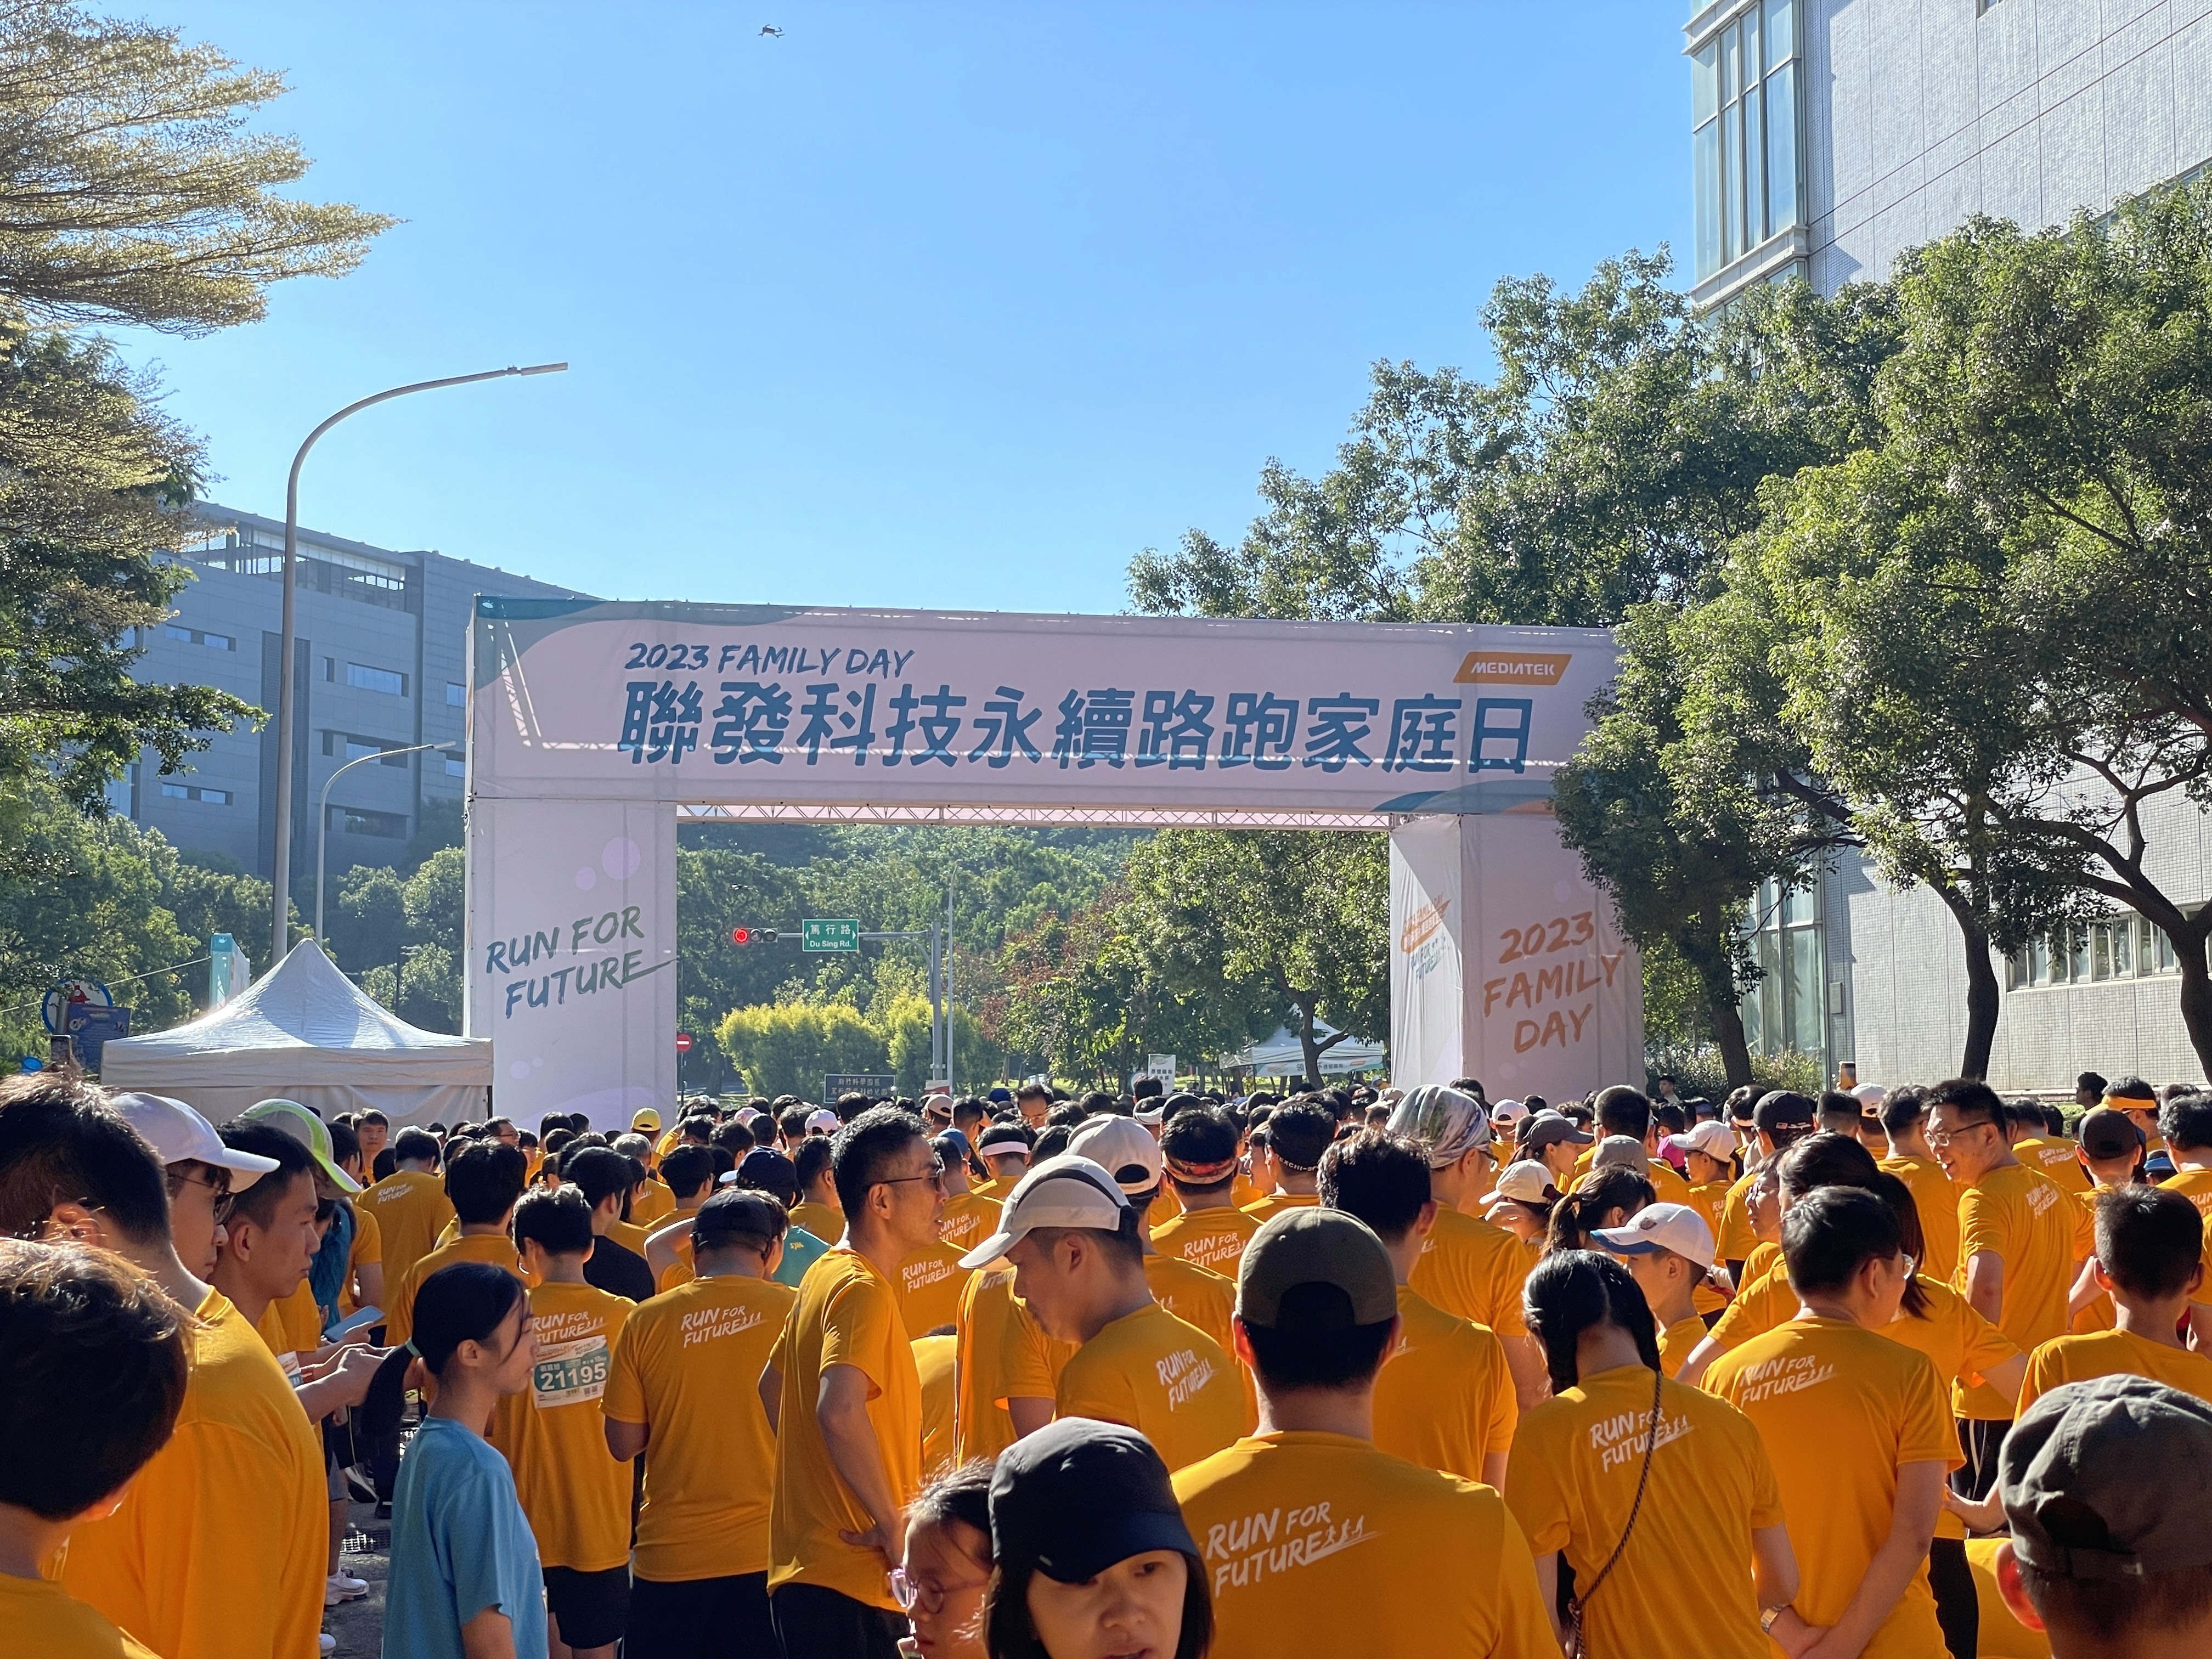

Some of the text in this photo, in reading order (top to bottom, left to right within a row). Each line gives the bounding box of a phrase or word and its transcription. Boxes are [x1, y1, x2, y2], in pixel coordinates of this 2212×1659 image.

[625, 642, 915, 679] 2023 FAMILY DAY
[1471, 662, 1555, 675] MEDIATEK
[618, 681, 1533, 774] 聯發科技永續路跑家庭日
[486, 906, 644, 974] RUN FOR
[822, 940, 838, 949] Sing
[1499, 911, 1595, 964] 2023
[506, 950, 677, 1019] FUTURE
[1484, 949, 1626, 1018] FAMILY
[1514, 1003, 1593, 1054] DAY
[939, 1213, 970, 1235] UN FOR
[939, 1222, 979, 1242] UTURE
[1184, 1232, 1238, 1257] RUN FOR
[1190, 1244, 1244, 1266] UTURE
[902, 1259, 944, 1280] RUN FOR
[907, 1269, 955, 1294] FUTURE
[532, 1311, 589, 1332] RUN FOR
[681, 1305, 746, 1331] RUN FOR
[684, 1318, 765, 1348] FUTURE
[540, 1362, 606, 1391] 21195
[1156, 1351, 1186, 1386] RUN
[1740, 1355, 1815, 1387] RUN FOR
[1741, 1372, 1832, 1409] FUTURE
[1590, 1411, 1634, 1449] RUN
[1206, 1501, 1331, 1560] RUN FOR
[1215, 1530, 1376, 1598] FUTURE
